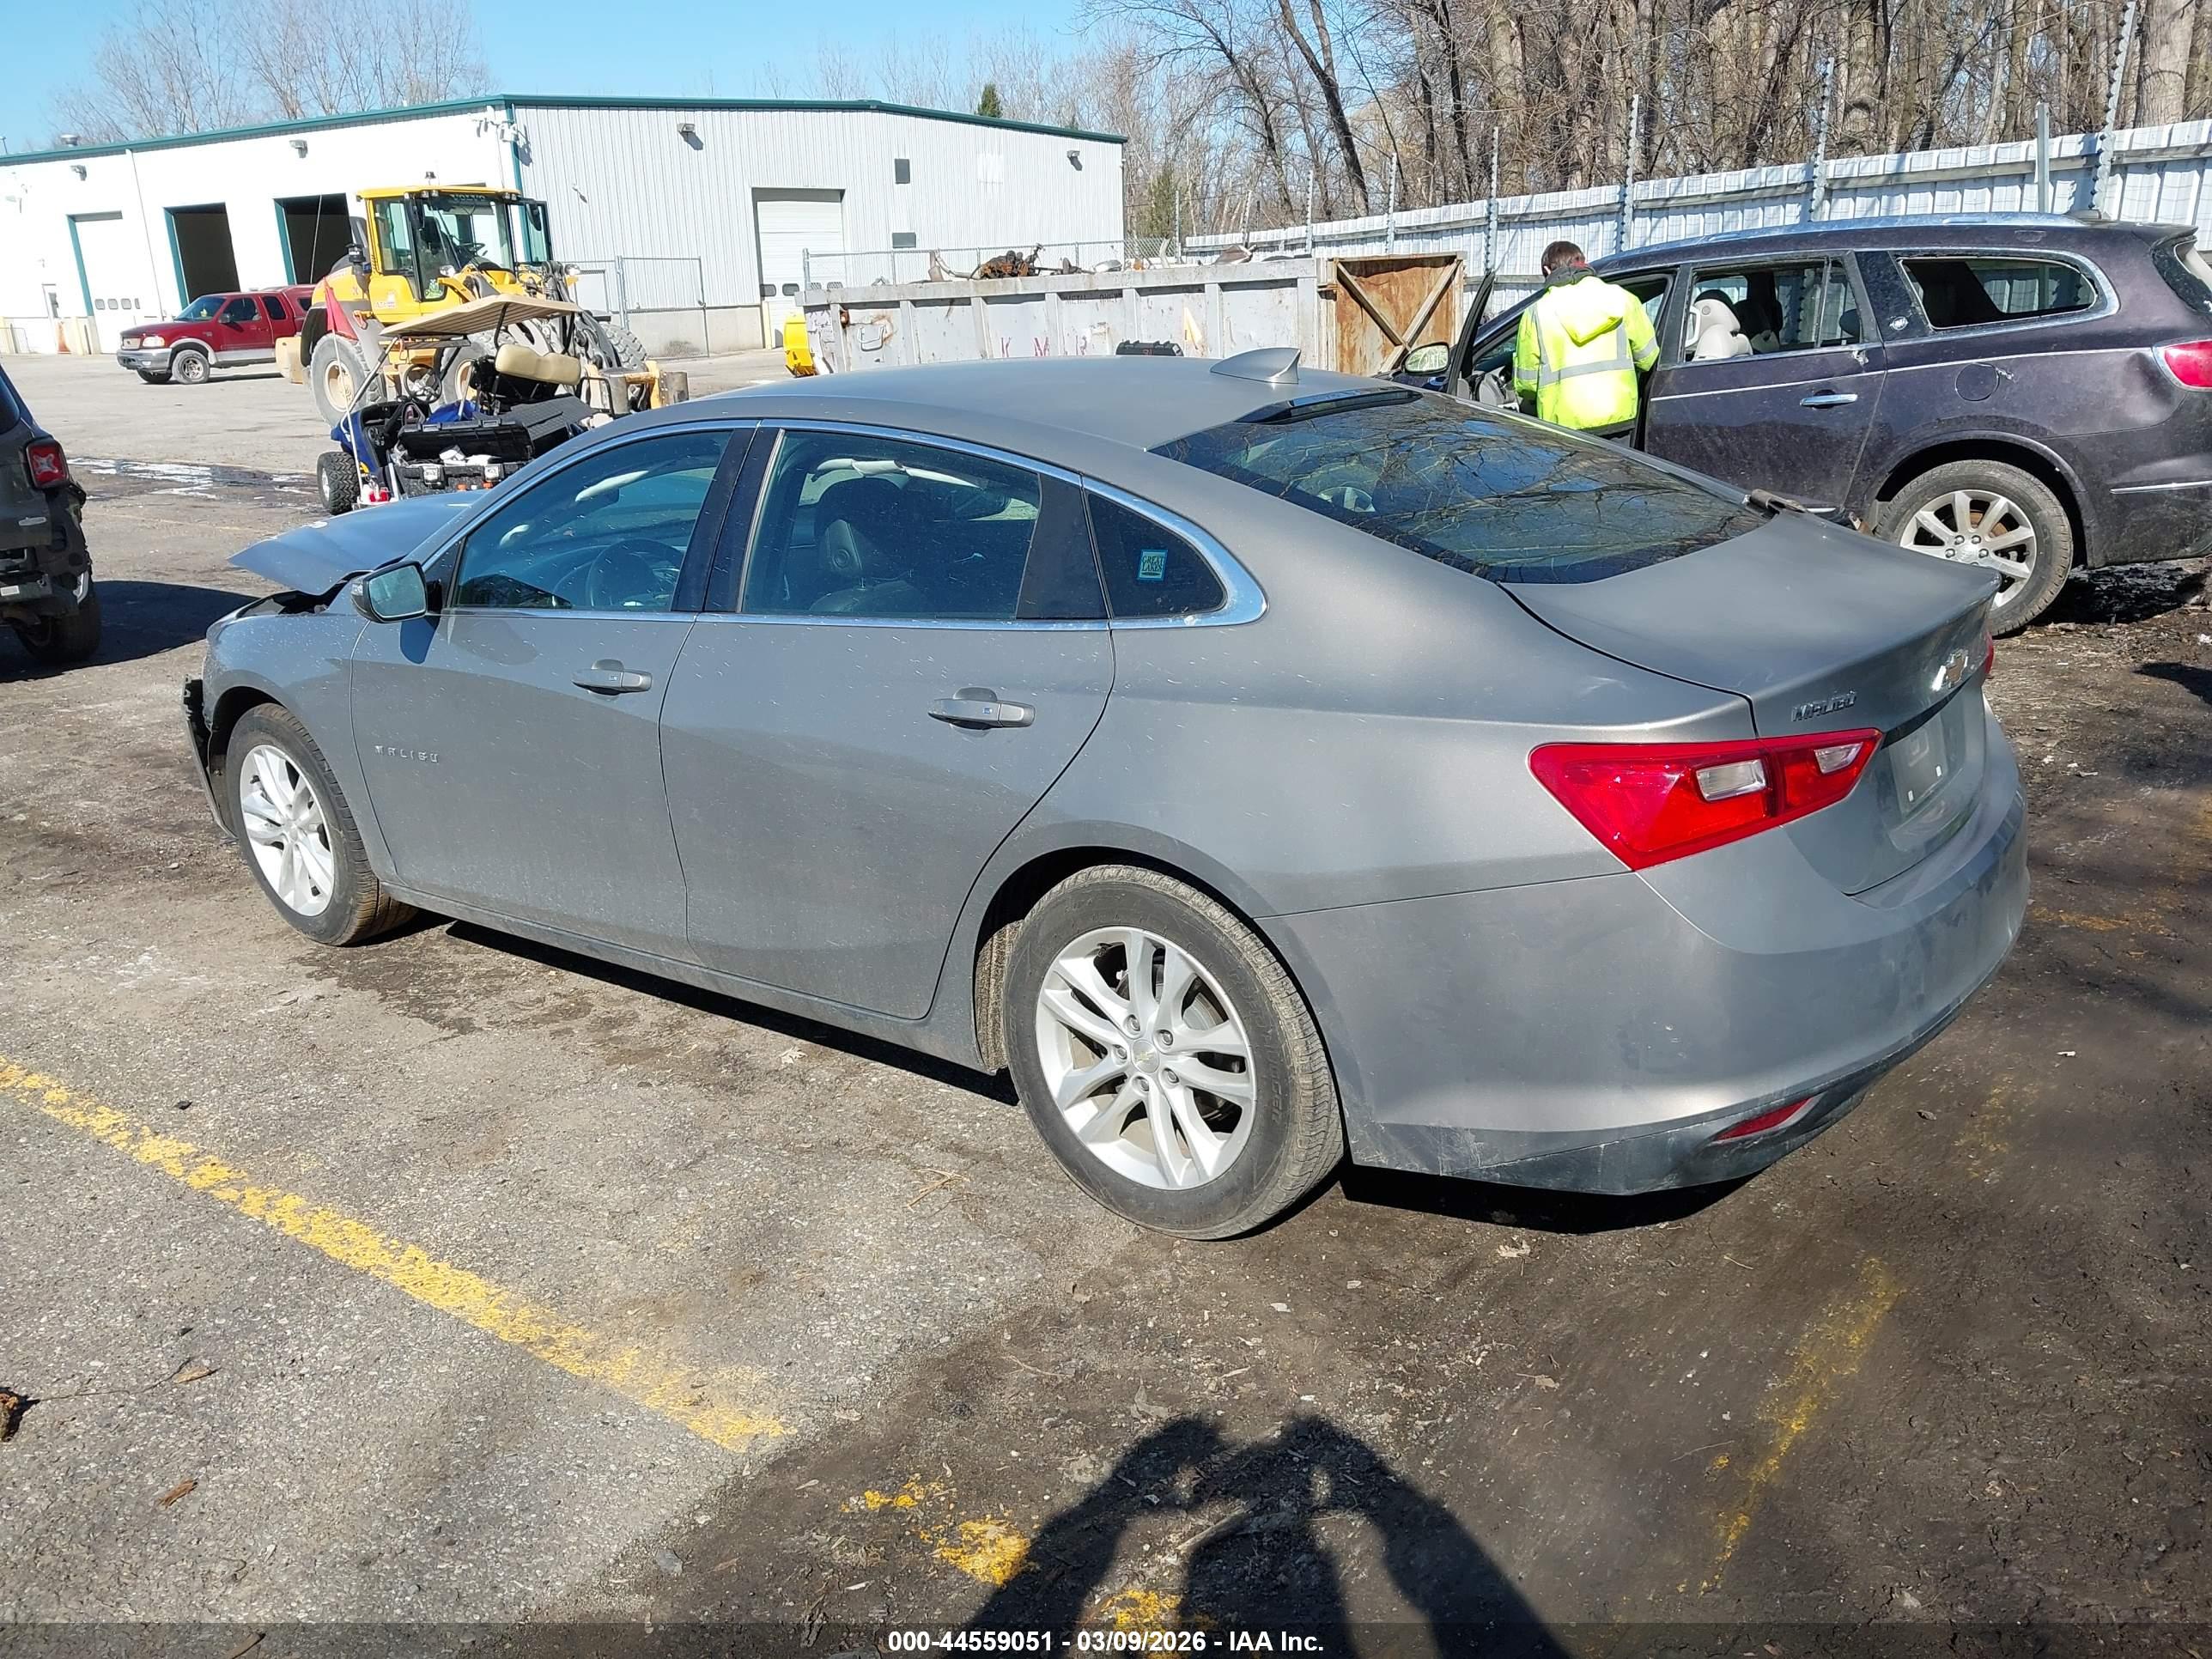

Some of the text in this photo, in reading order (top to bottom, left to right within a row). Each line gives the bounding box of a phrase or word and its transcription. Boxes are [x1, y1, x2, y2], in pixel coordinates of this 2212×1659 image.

[449, 193, 486, 202] VOLVO
[1141, 555, 1164, 564] GREAT
[1141, 563, 1163, 572] LAKES
[1791, 690, 1856, 721] MALIBU
[374, 744, 439, 763] MALIBU
